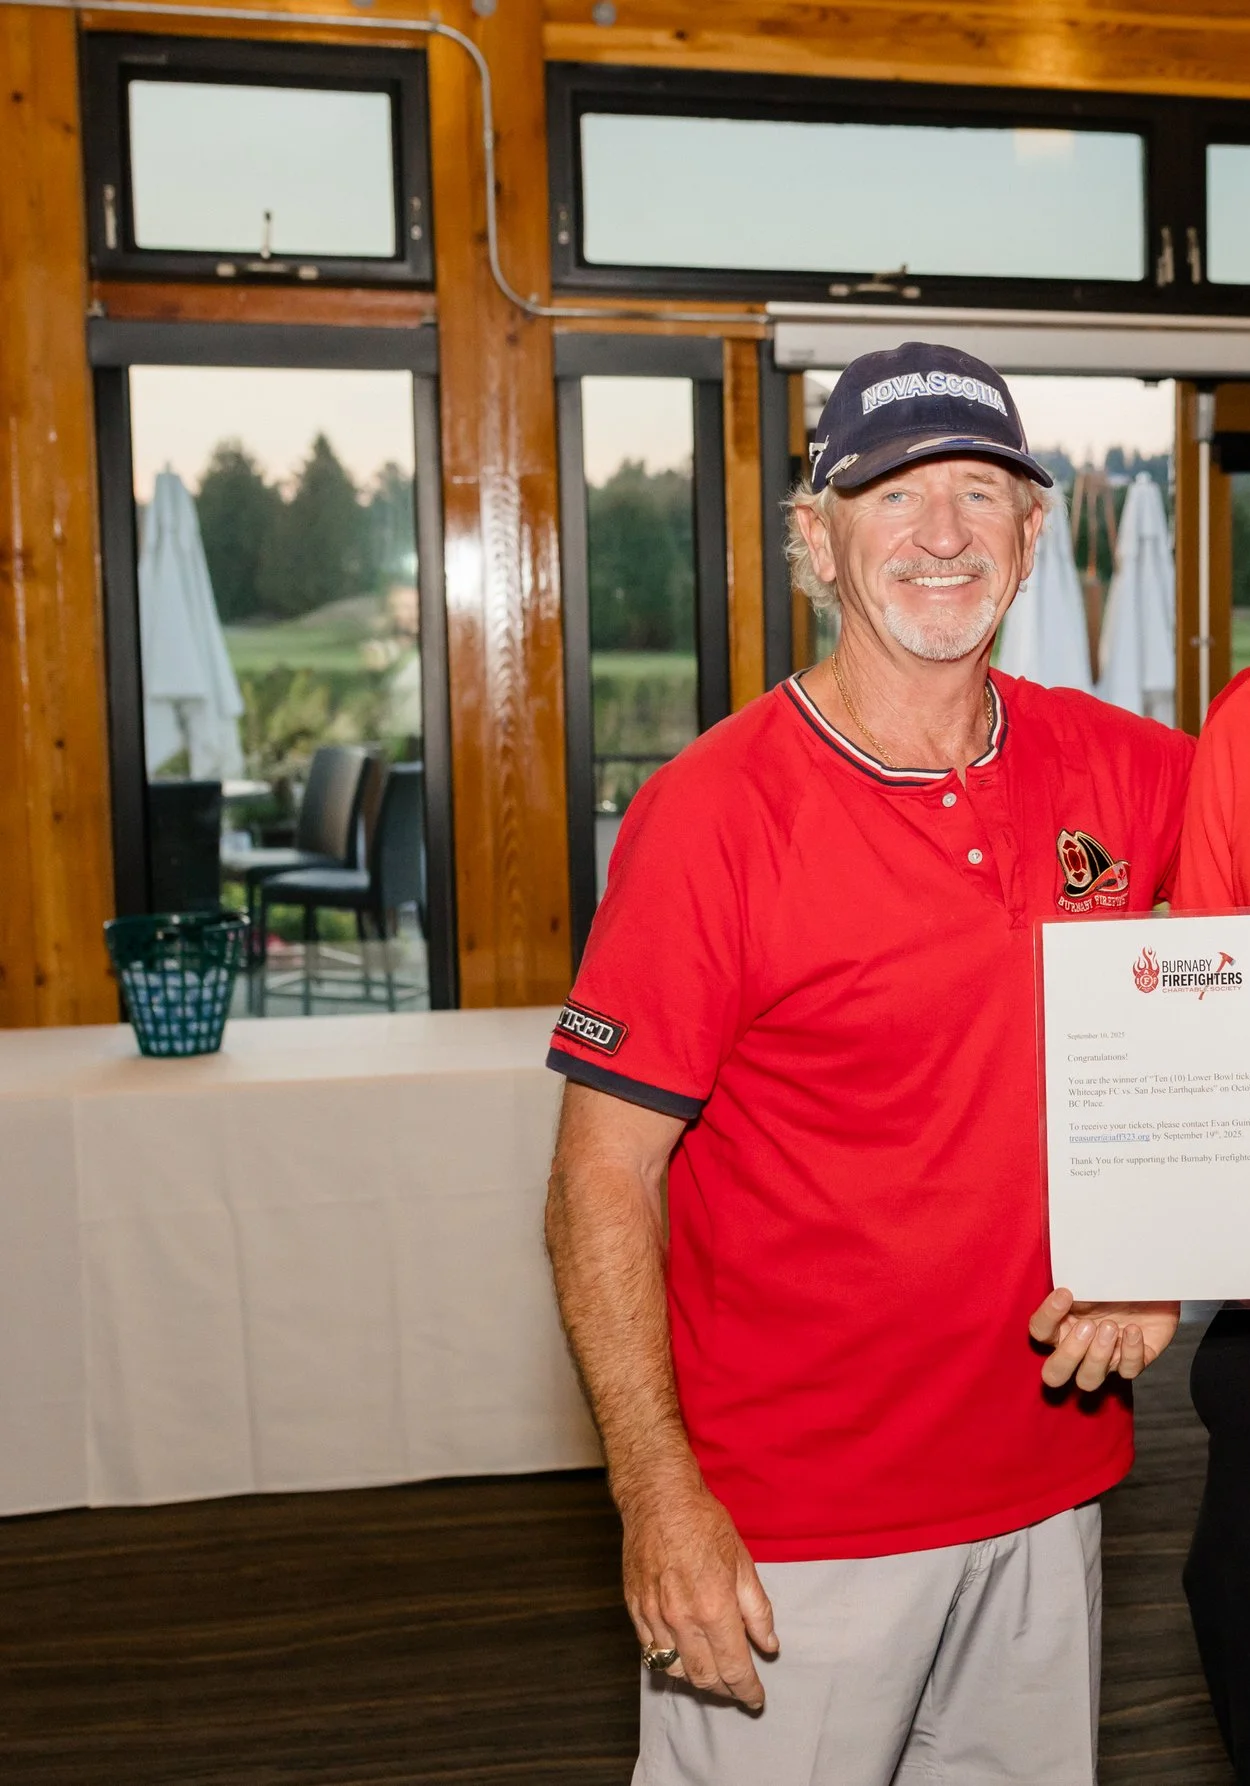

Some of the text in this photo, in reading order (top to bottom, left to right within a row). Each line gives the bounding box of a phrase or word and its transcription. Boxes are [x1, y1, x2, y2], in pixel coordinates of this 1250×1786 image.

[861, 371, 1008, 416] NOVA SCOTIA
[1162, 959, 1213, 973] BURNABY
[1162, 972, 1243, 987] FIREFIGHTERS
[1162, 986, 1209, 994] CHARITABLE
[1067, 1033, 1098, 1041] September
[1068, 1053, 1128, 1064] Congratulations!
[1069, 1077, 1084, 1085] You
[1170, 1074, 1186, 1084] (10)
[1188, 1074, 1211, 1082] Lower
[1214, 1073, 1234, 1081] Bowl
[1069, 1088, 1107, 1097] Whitecaps
[1135, 1087, 1148, 1095] San
[1069, 1100, 1080, 1108] BC
[1110, 1124, 1127, 1132] your
[1129, 1122, 1155, 1130] tickets,
[1157, 1121, 1180, 1130] please
[1182, 1120, 1208, 1128] contact
[1069, 1133, 1150, 1143] treasurer@iaff323.org
[1152, 1132, 1161, 1141] by
[1164, 1131, 1203, 1141] September
[1071, 1157, 1093, 1165] Thank
[1114, 1156, 1124, 1164] for
[1126, 1156, 1166, 1165] supporting
[1168, 1155, 1179, 1163] the
[1181, 1154, 1213, 1164] Burnaby
[1070, 1169, 1100, 1178] Society!
